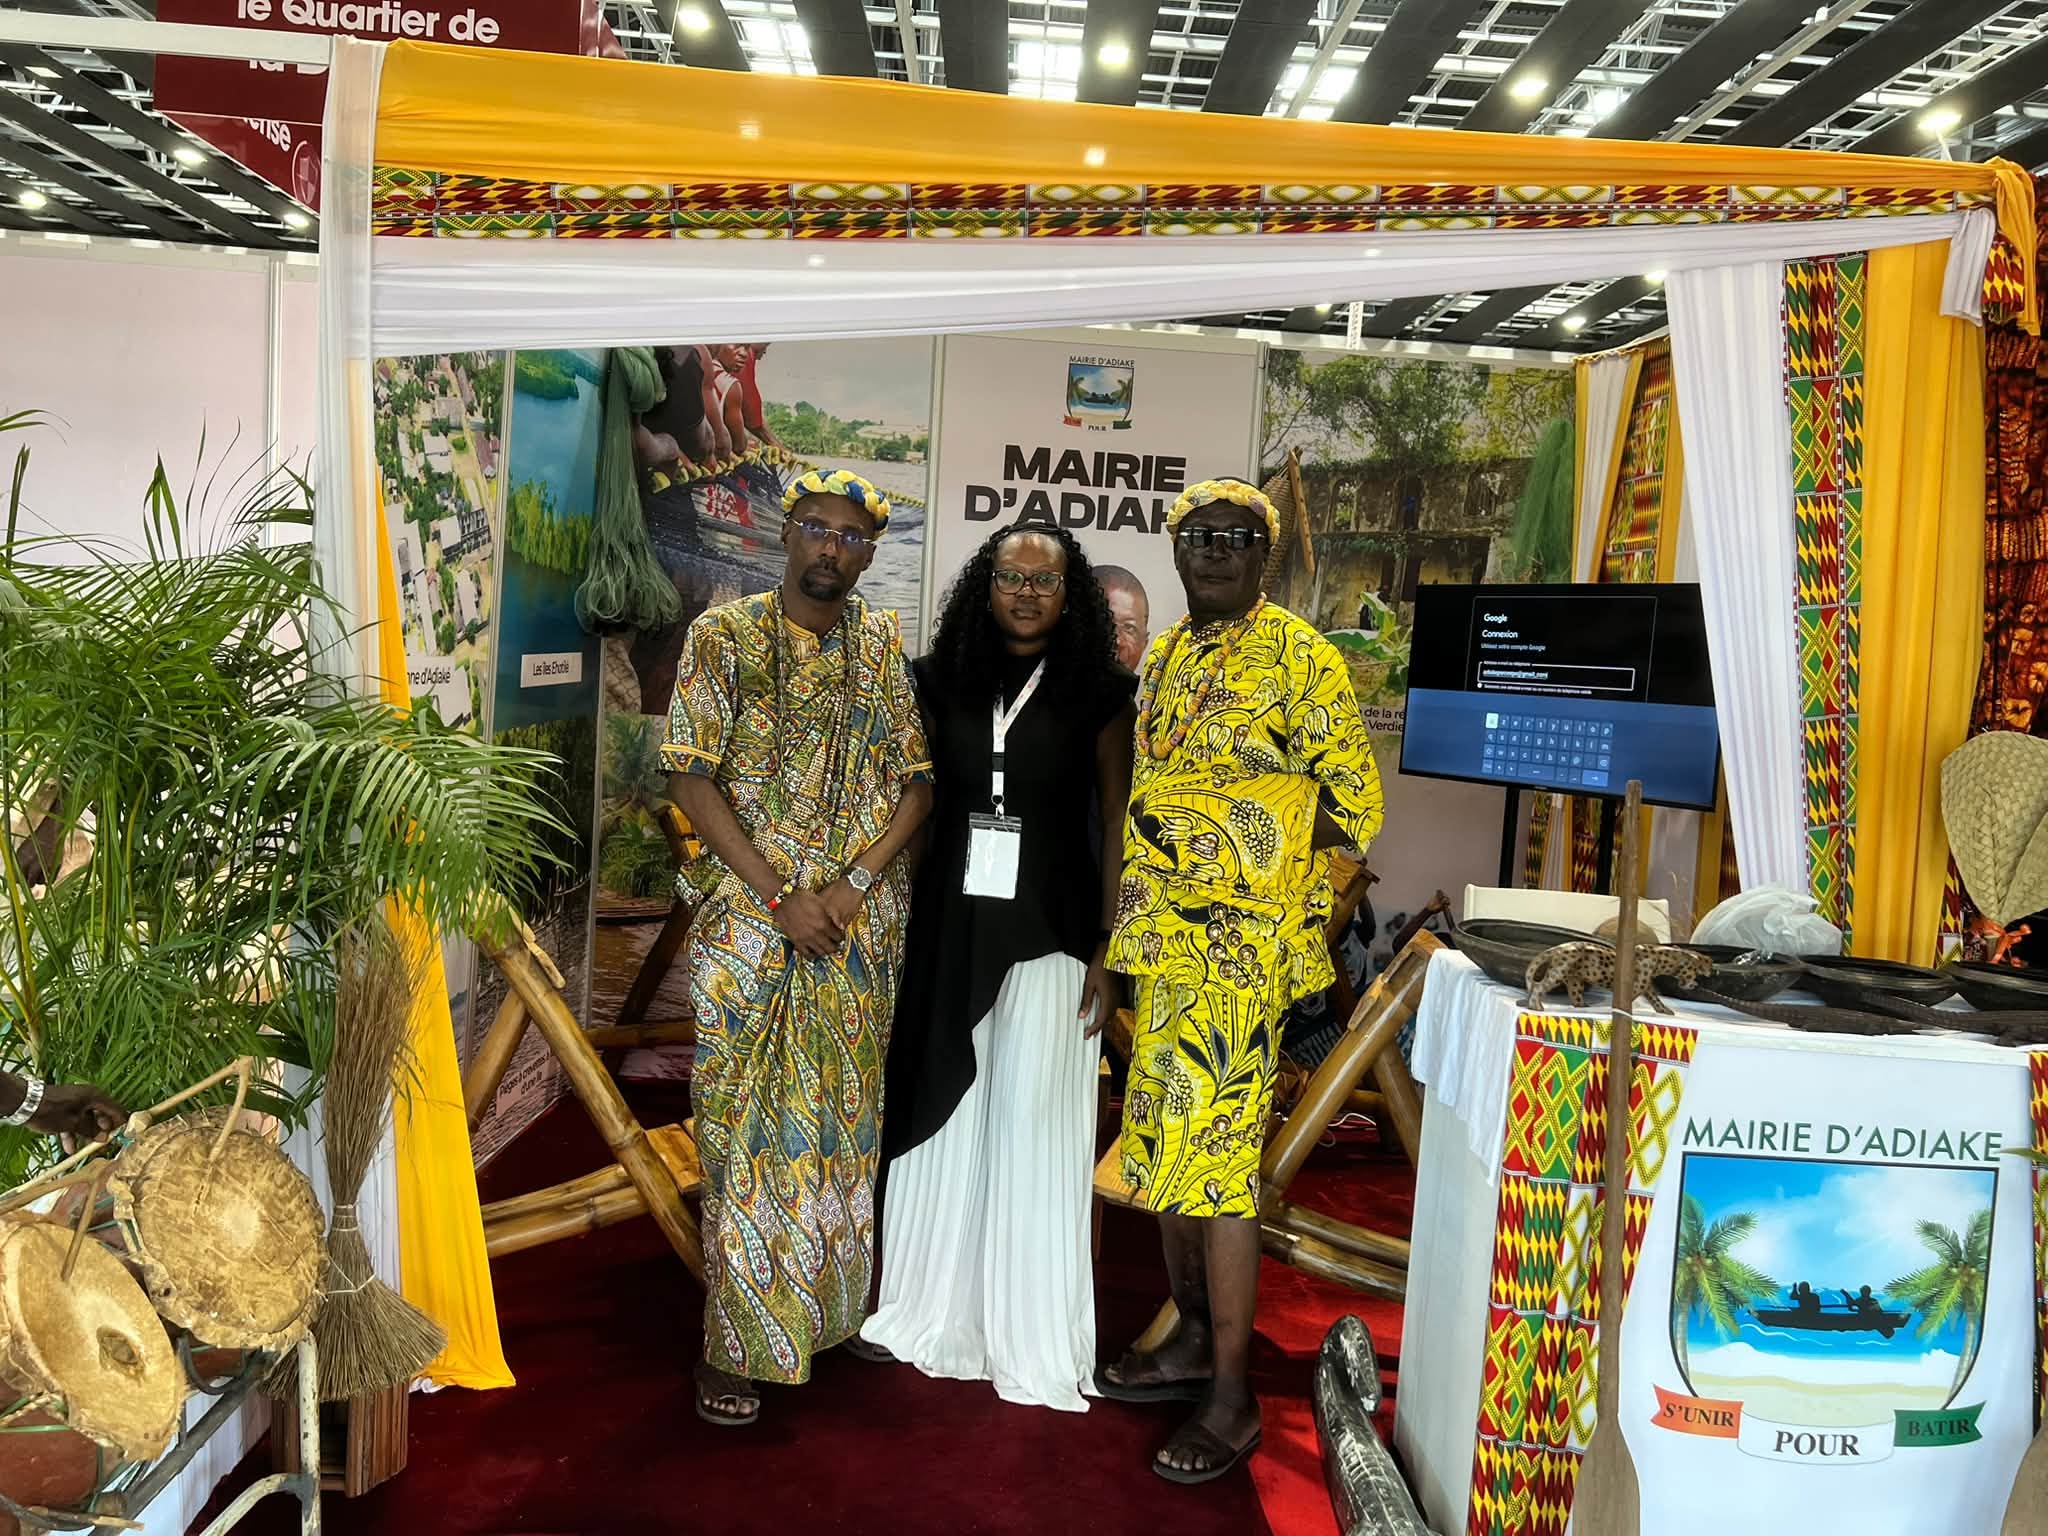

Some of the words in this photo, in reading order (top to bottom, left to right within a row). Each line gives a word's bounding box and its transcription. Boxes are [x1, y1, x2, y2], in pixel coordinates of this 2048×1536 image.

[282, 0, 440, 37] Quartier
[448, 9, 500, 44] de
[1069, 356, 1097, 365] MAIRIE
[1098, 358, 1135, 368] D'ADIAKE
[1003, 444, 1187, 493] MAIRIE
[1483, 613, 1507, 624] Google
[1482, 629, 1518, 639] Connexion
[533, 663, 542, 676] Les
[1364, 708, 1380, 718] de
[1382, 708, 1392, 718] la
[1682, 1116, 1812, 1153] MAIRIE
[1826, 1124, 2003, 1162] D'ADIAKE
[1663, 1402, 1734, 1427] S'UNIR
[1907, 1419, 1970, 1437] BATIR
[1773, 1430, 1860, 1457] POUR
